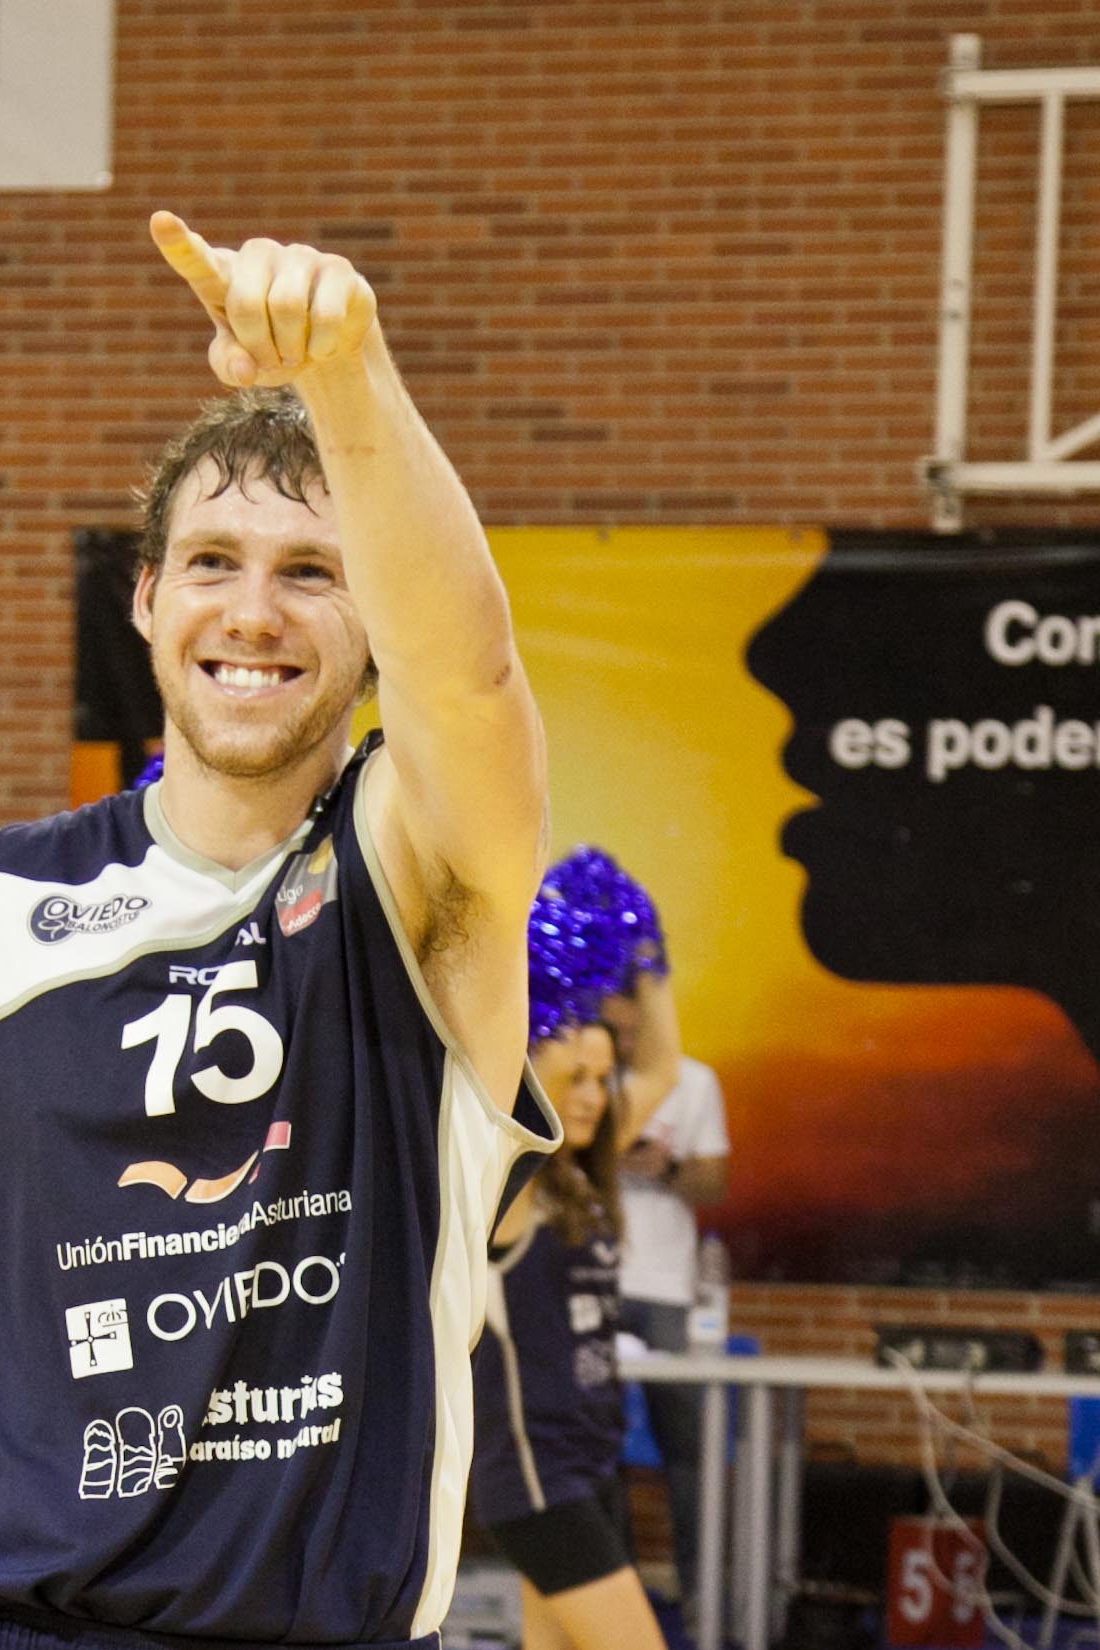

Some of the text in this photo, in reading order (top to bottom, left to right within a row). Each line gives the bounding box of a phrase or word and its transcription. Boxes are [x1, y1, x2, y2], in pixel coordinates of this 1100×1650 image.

[830, 704, 1100, 782] es pode
[44, 897, 149, 922] OVIEDO
[121, 960, 284, 1117] 15
